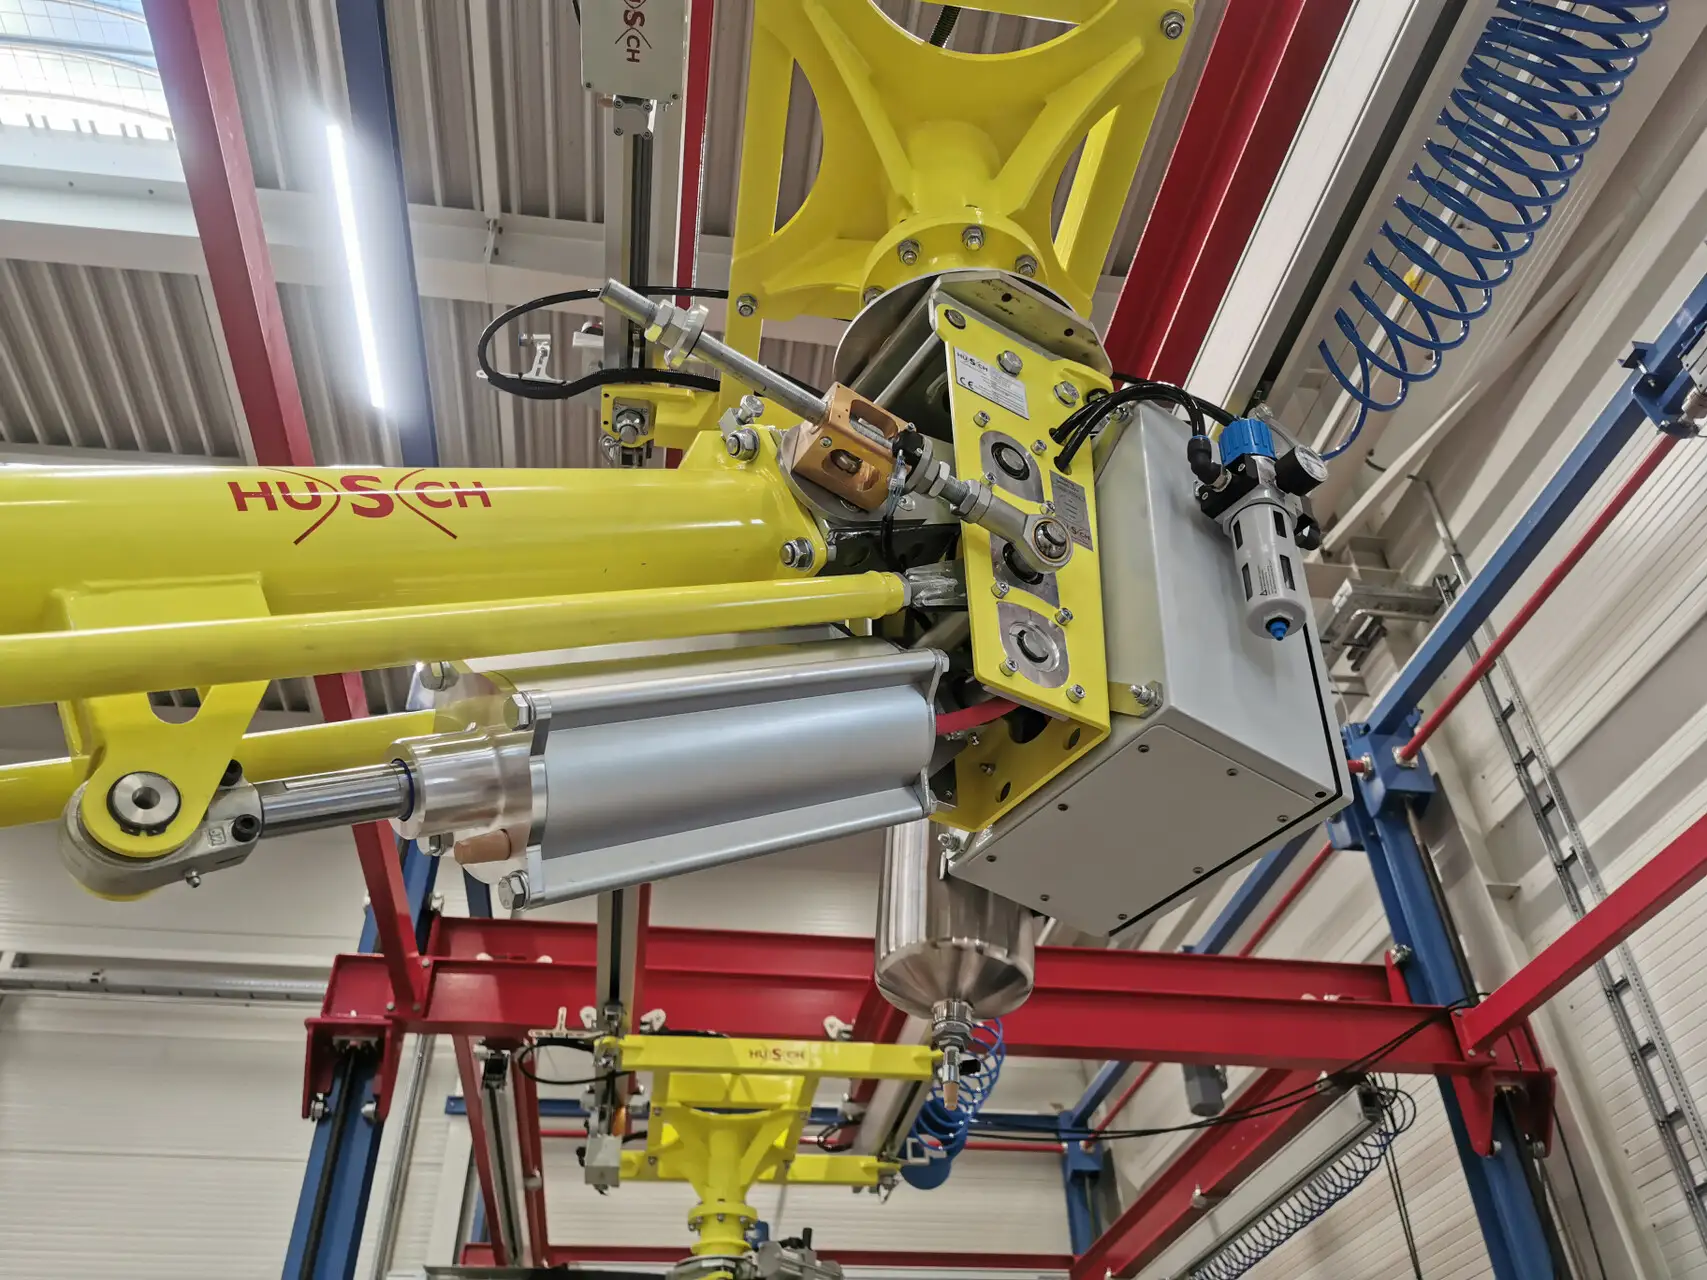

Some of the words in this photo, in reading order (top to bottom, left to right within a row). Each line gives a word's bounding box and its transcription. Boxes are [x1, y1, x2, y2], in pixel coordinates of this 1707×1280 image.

[623, 0, 645, 63] SCH
[227, 474, 492, 519] HUSCH
[749, 1047, 805, 1062] HUSCH
